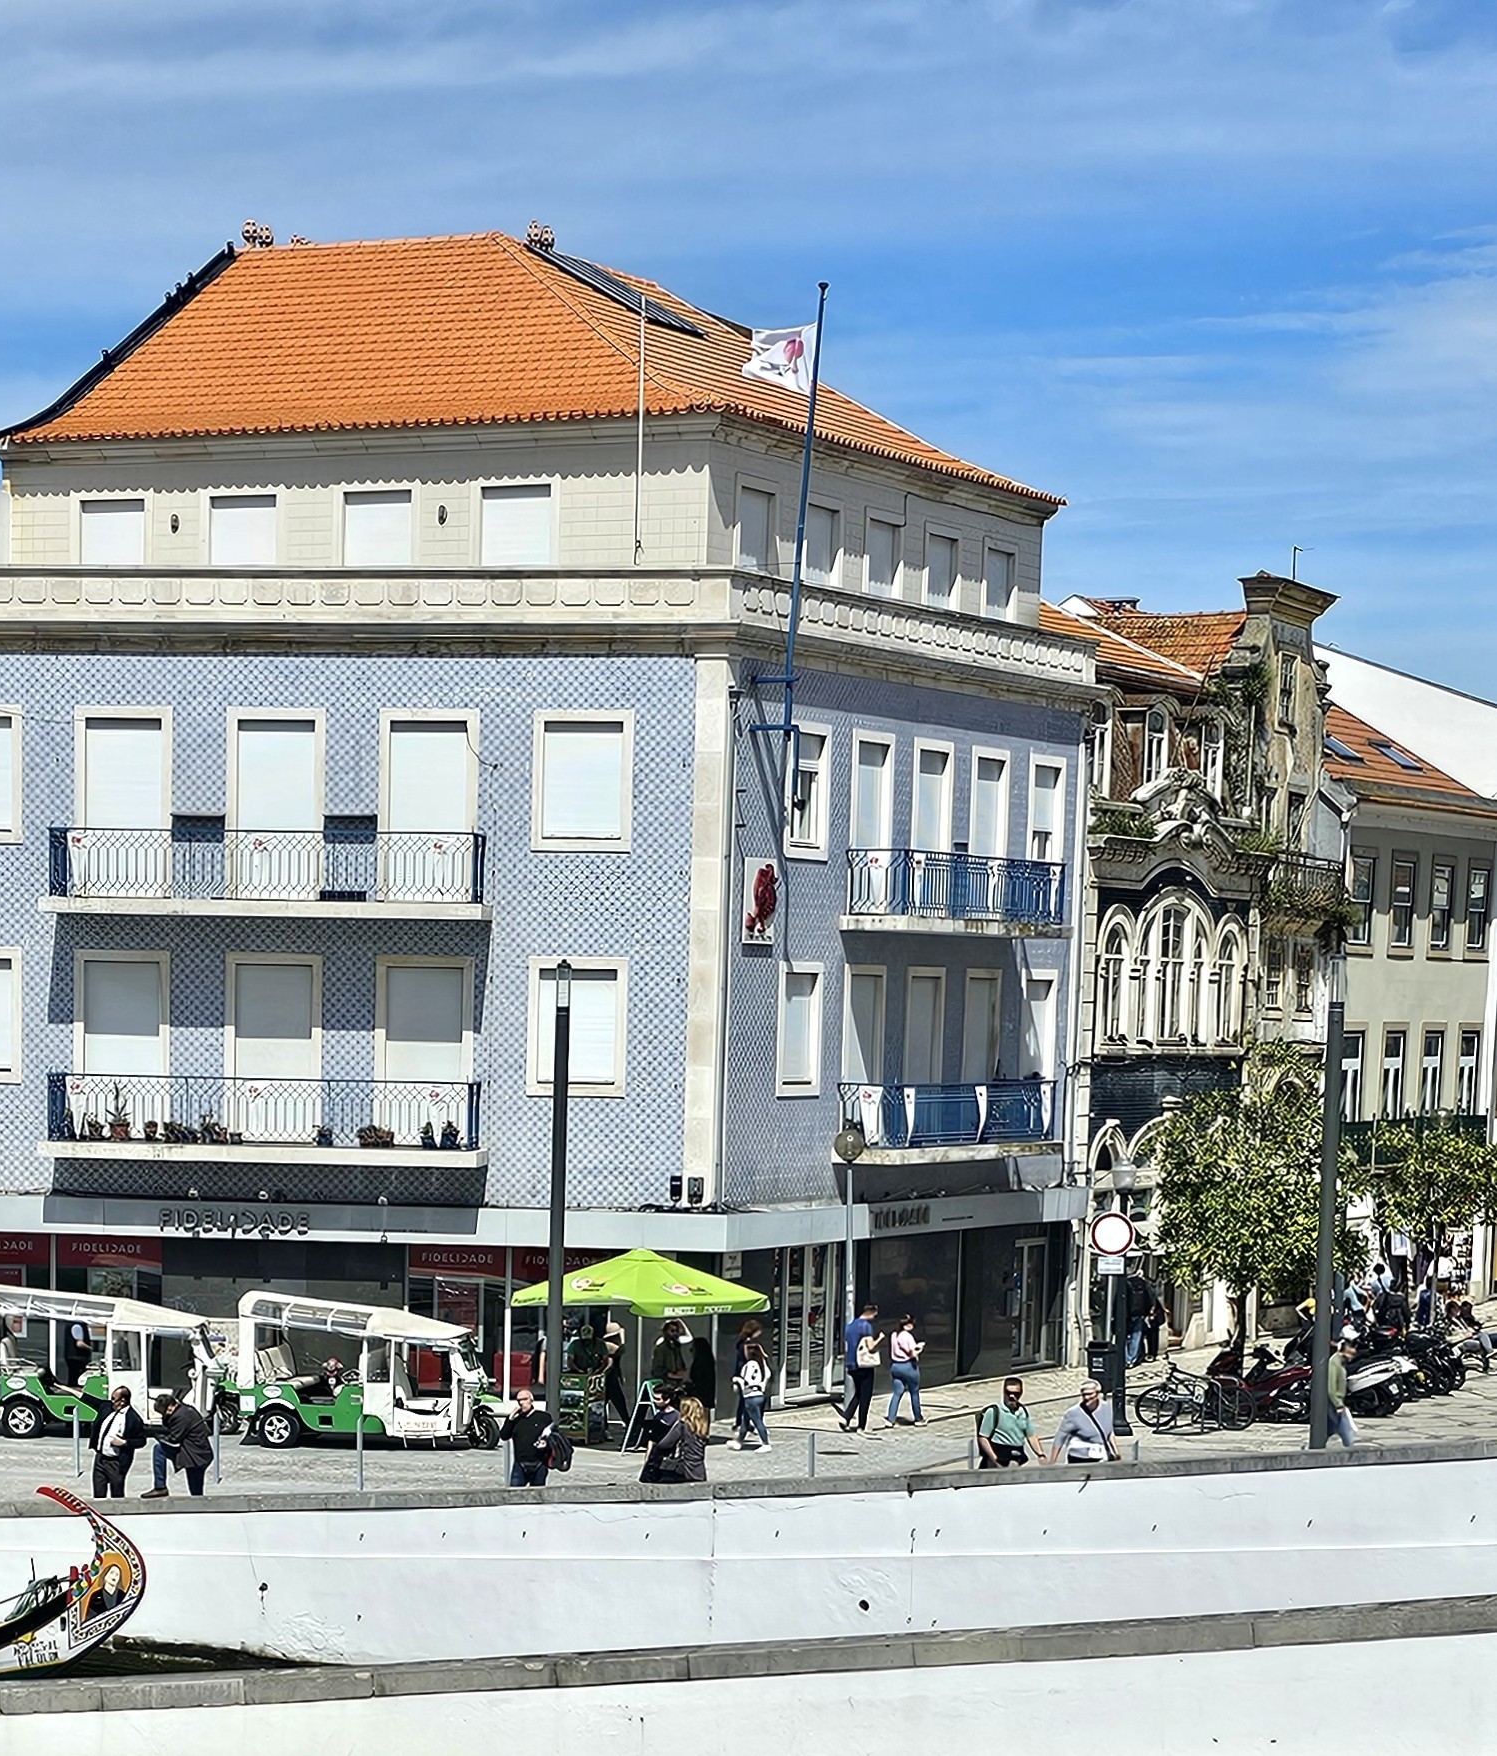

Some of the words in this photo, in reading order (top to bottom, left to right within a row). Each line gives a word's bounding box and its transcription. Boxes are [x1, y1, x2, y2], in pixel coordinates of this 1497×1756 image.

[159, 1208, 311, 1236] FIDELIDADE
[71, 1241, 143, 1254] FIDELIDADE
[421, 1251, 494, 1265] FIDELIDADE
